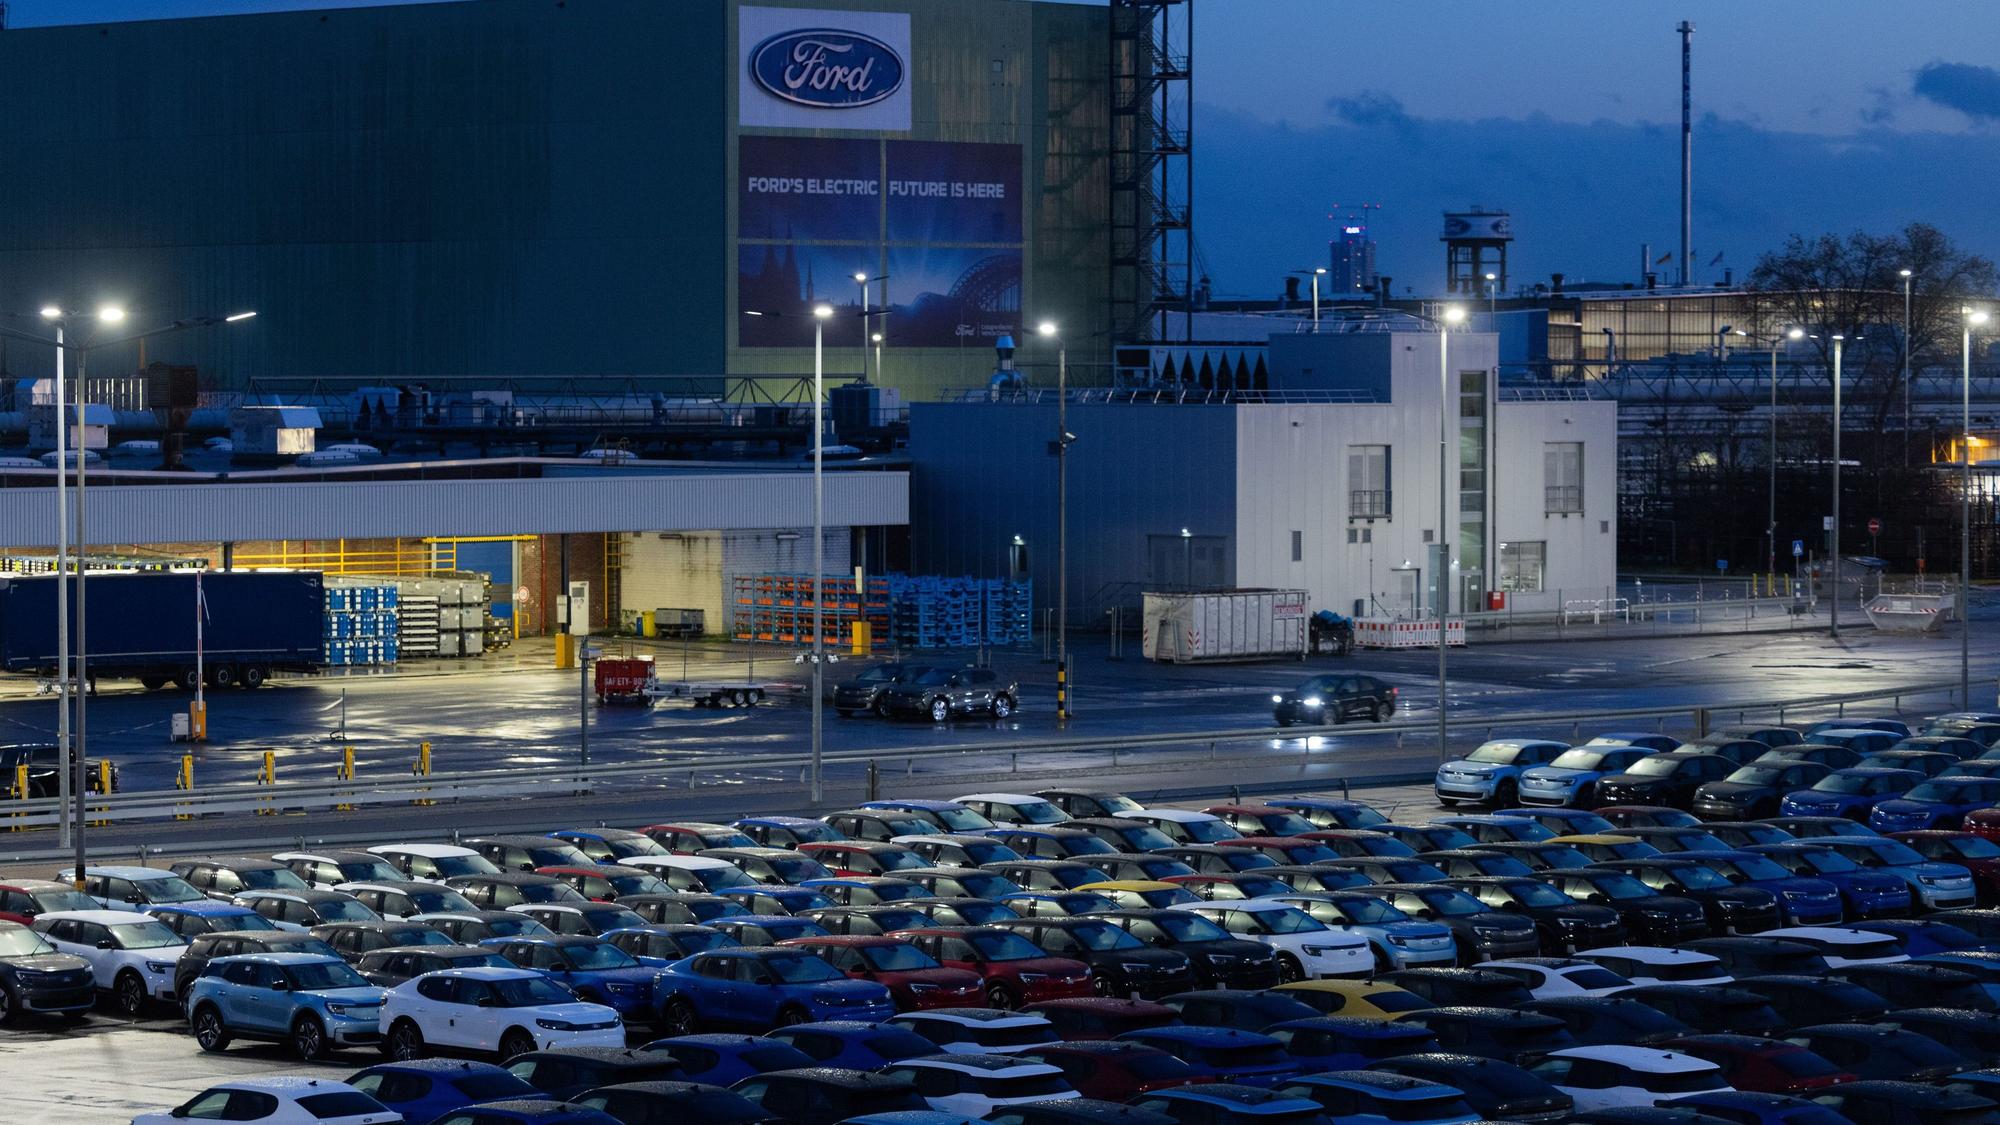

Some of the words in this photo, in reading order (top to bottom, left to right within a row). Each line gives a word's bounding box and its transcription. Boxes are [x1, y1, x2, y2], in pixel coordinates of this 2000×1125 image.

[784, 40, 874, 91] Ford
[748, 177, 804, 194] FORD'S
[806, 178, 878, 195] ELECTRIC
[889, 180, 947, 197] FUTURE
[950, 182, 965, 197] IS
[967, 183, 1005, 198] HERE
[955, 324, 975, 336] Ford
